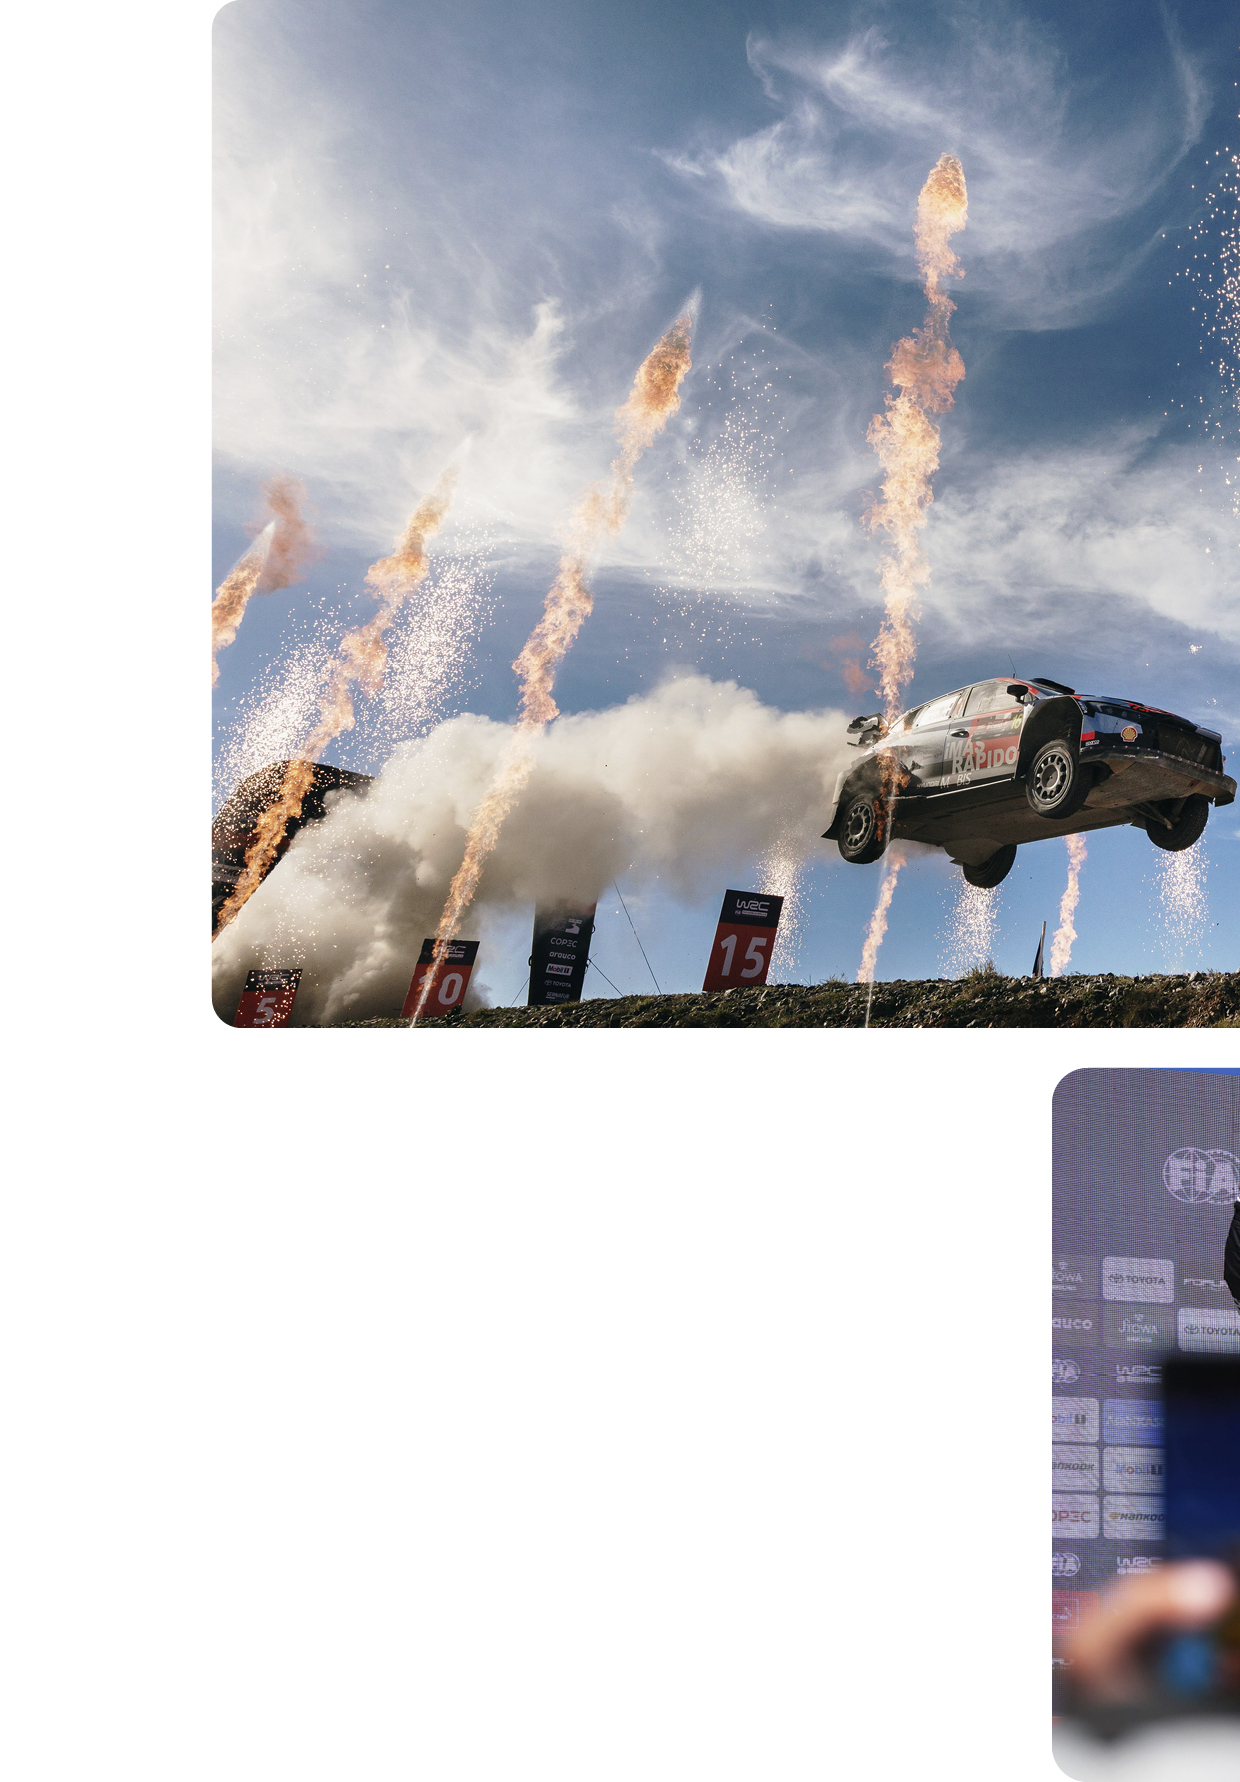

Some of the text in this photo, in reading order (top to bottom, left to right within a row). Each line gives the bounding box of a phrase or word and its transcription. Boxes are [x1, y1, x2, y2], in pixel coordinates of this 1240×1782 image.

[940, 773, 972, 788] MBIS
[736, 899, 770, 911] WRC
[550, 937, 578, 948] COPEC
[549, 951, 576, 960] arauco
[720, 934, 768, 978] 15
[418, 972, 463, 1005] 10
[252, 997, 276, 1024] 5
[1125, 1276, 1166, 1285] TOYOTA
[1052, 1317, 1093, 1330] auco
[1202, 1326, 1240, 1336] TOYOTA
[1052, 1461, 1095, 1472] ankook
